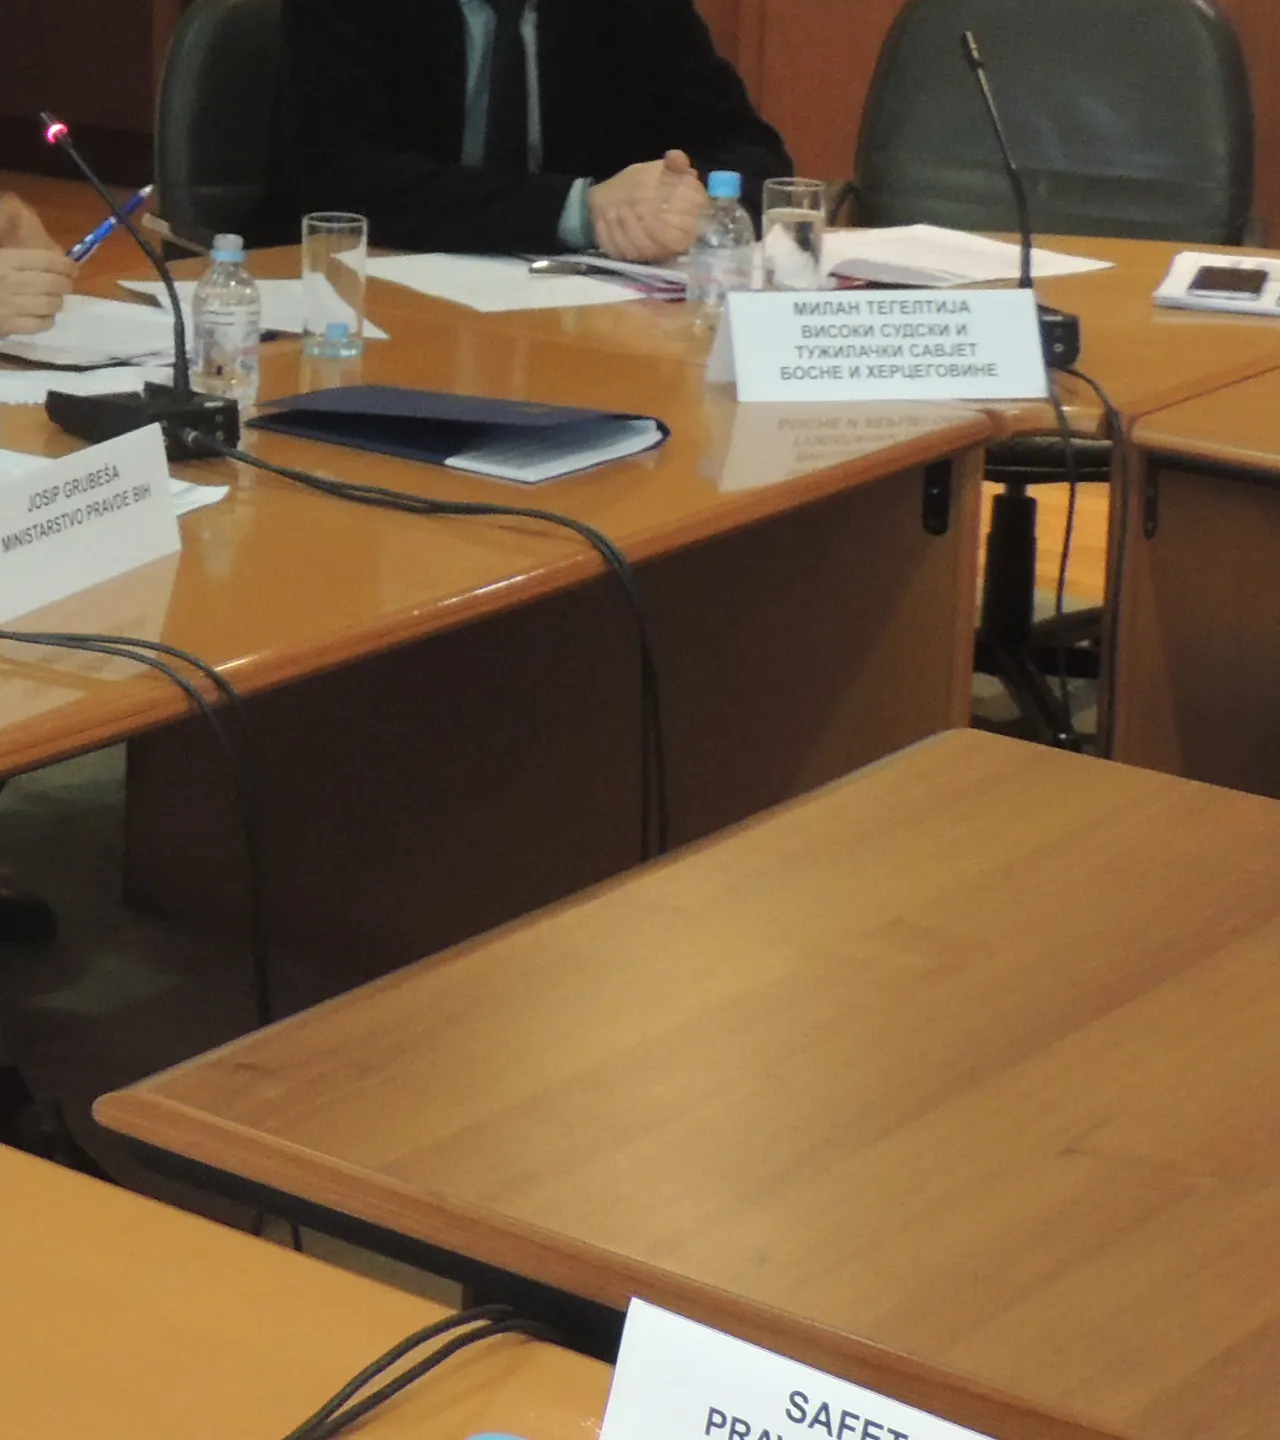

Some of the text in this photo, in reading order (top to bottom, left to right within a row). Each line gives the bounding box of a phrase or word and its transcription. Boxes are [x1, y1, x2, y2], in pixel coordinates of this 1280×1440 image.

[793, 299, 972, 316] МИЛАН ТЕГЕЛТИЈА
[800, 323, 969, 339] ВИСОКИ СУДСКИ И
[794, 342, 979, 360] ТУЖИЛАЧКИ САВЈЕТ
[779, 362, 999, 381] БОСНЕ И ХЕРЦЕГОВИНЕ
[27, 462, 121, 513] JOSIP GRUBEŠA
[1, 481, 152, 554] MINISTARSTVO PRAVDE BIH
[704, 1406, 784, 1440] PR
